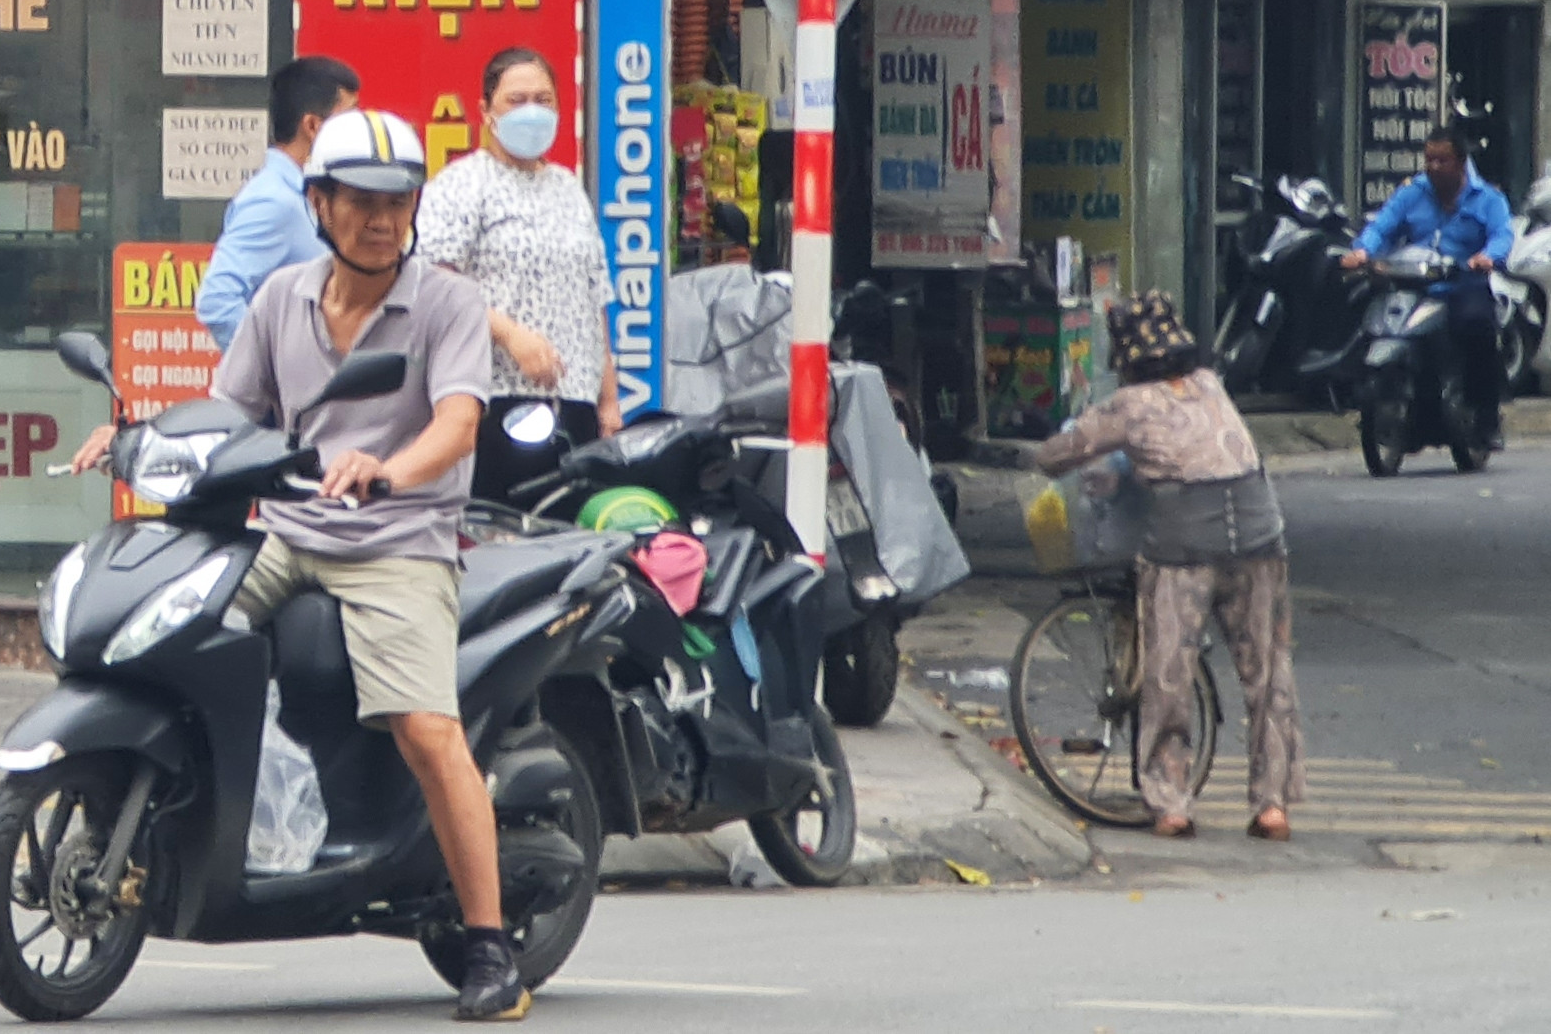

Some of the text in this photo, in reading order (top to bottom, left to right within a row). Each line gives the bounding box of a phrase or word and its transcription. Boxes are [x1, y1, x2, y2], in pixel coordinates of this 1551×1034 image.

[1365, 31, 1437, 79] TÓC
[7, 121, 67, 171] VÀO
[604, 40, 661, 427] vinaphone
[123, 250, 207, 308] BÁN
